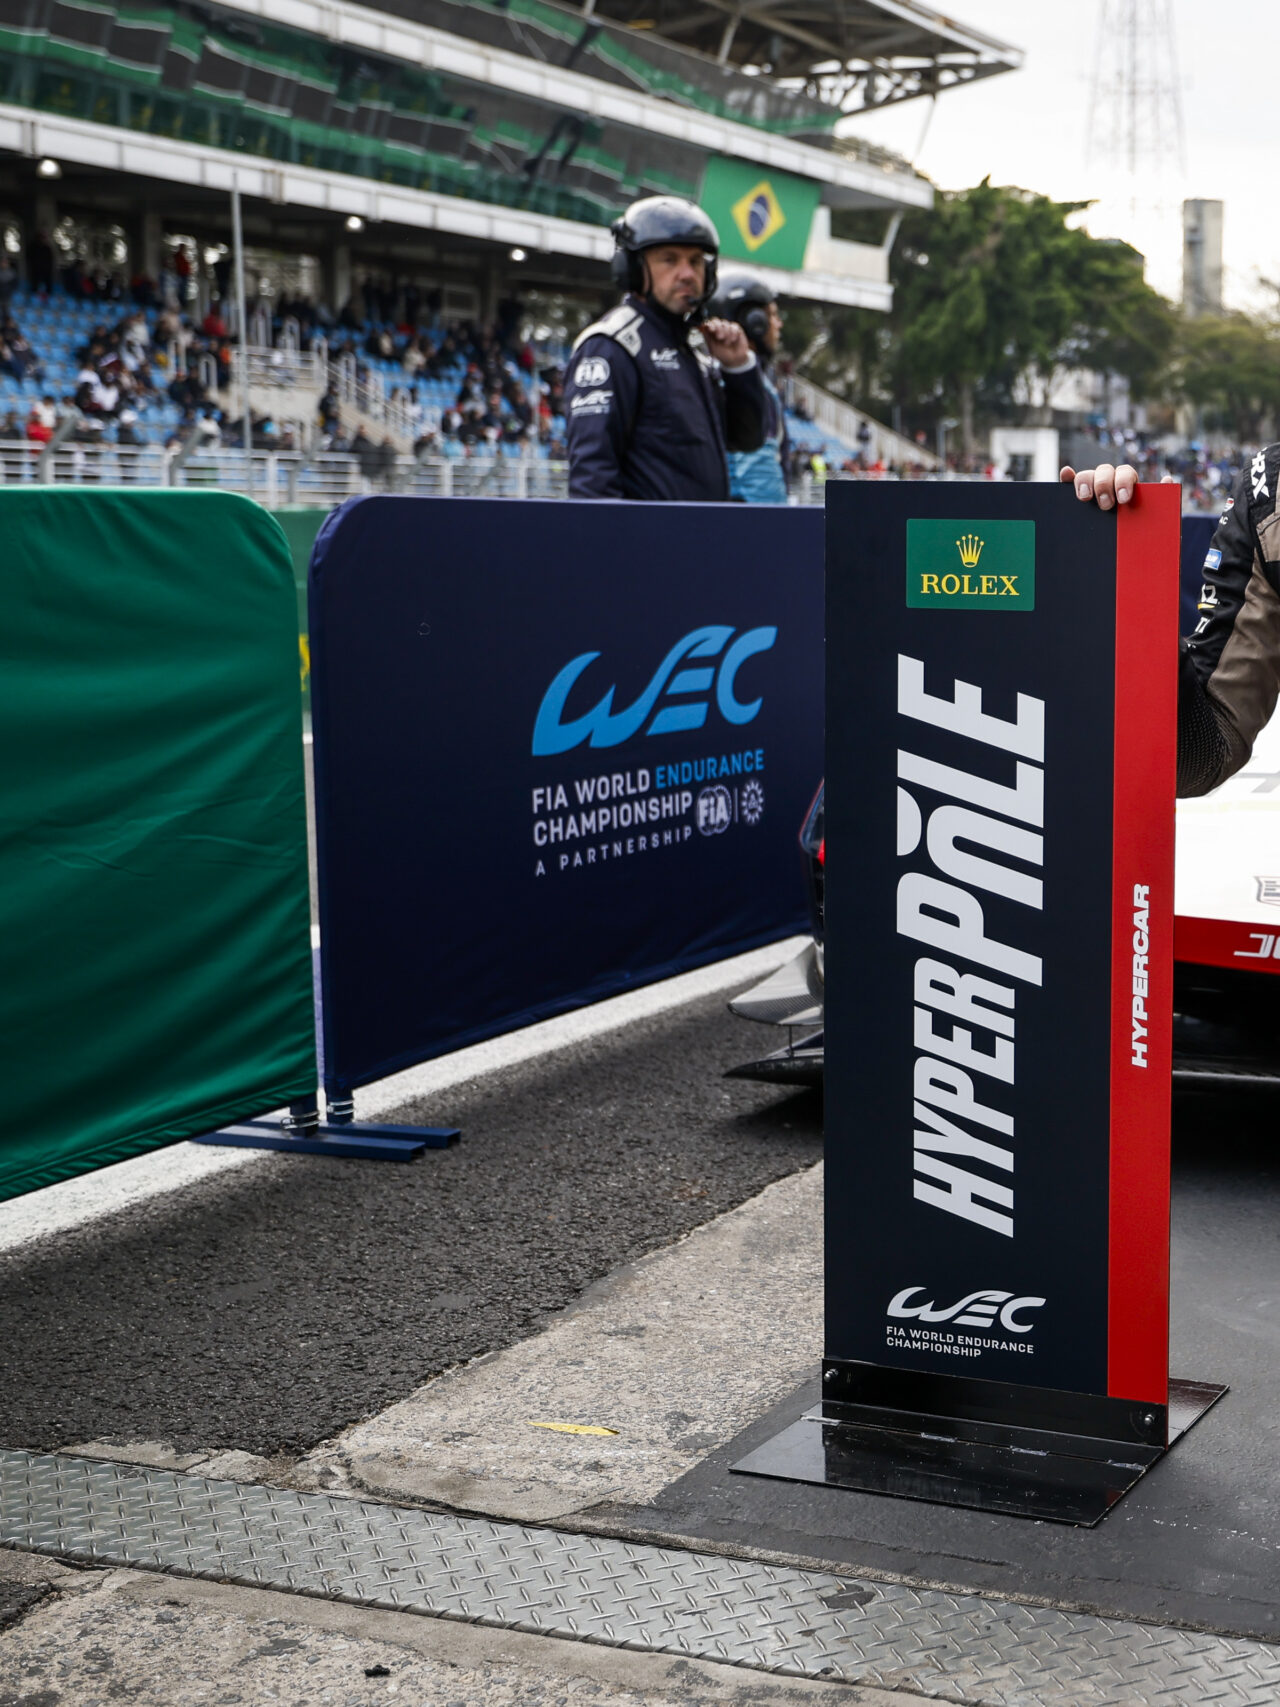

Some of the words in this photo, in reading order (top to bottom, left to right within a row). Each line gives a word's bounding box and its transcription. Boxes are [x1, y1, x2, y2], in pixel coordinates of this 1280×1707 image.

[920, 573, 1020, 596] ROLEX
[532, 624, 778, 756] WEC
[532, 784, 569, 814] FIA
[574, 768, 651, 805] WORLD
[655, 748, 765, 789] ENDURANCE
[533, 790, 693, 847] CHAMPIONSHIP
[535, 859, 546, 877] A
[559, 825, 693, 870] PARTNERSHIP
[1131, 883, 1150, 1068] HYPERCAR
[886, 1286, 1047, 1333] WEC
[886, 1325, 906, 1337] FIA
[909, 1328, 955, 1343] WORLD
[957, 1335, 1034, 1354] ENDURANCE
[886, 1337, 982, 1358] CHAMPIONSHIP
